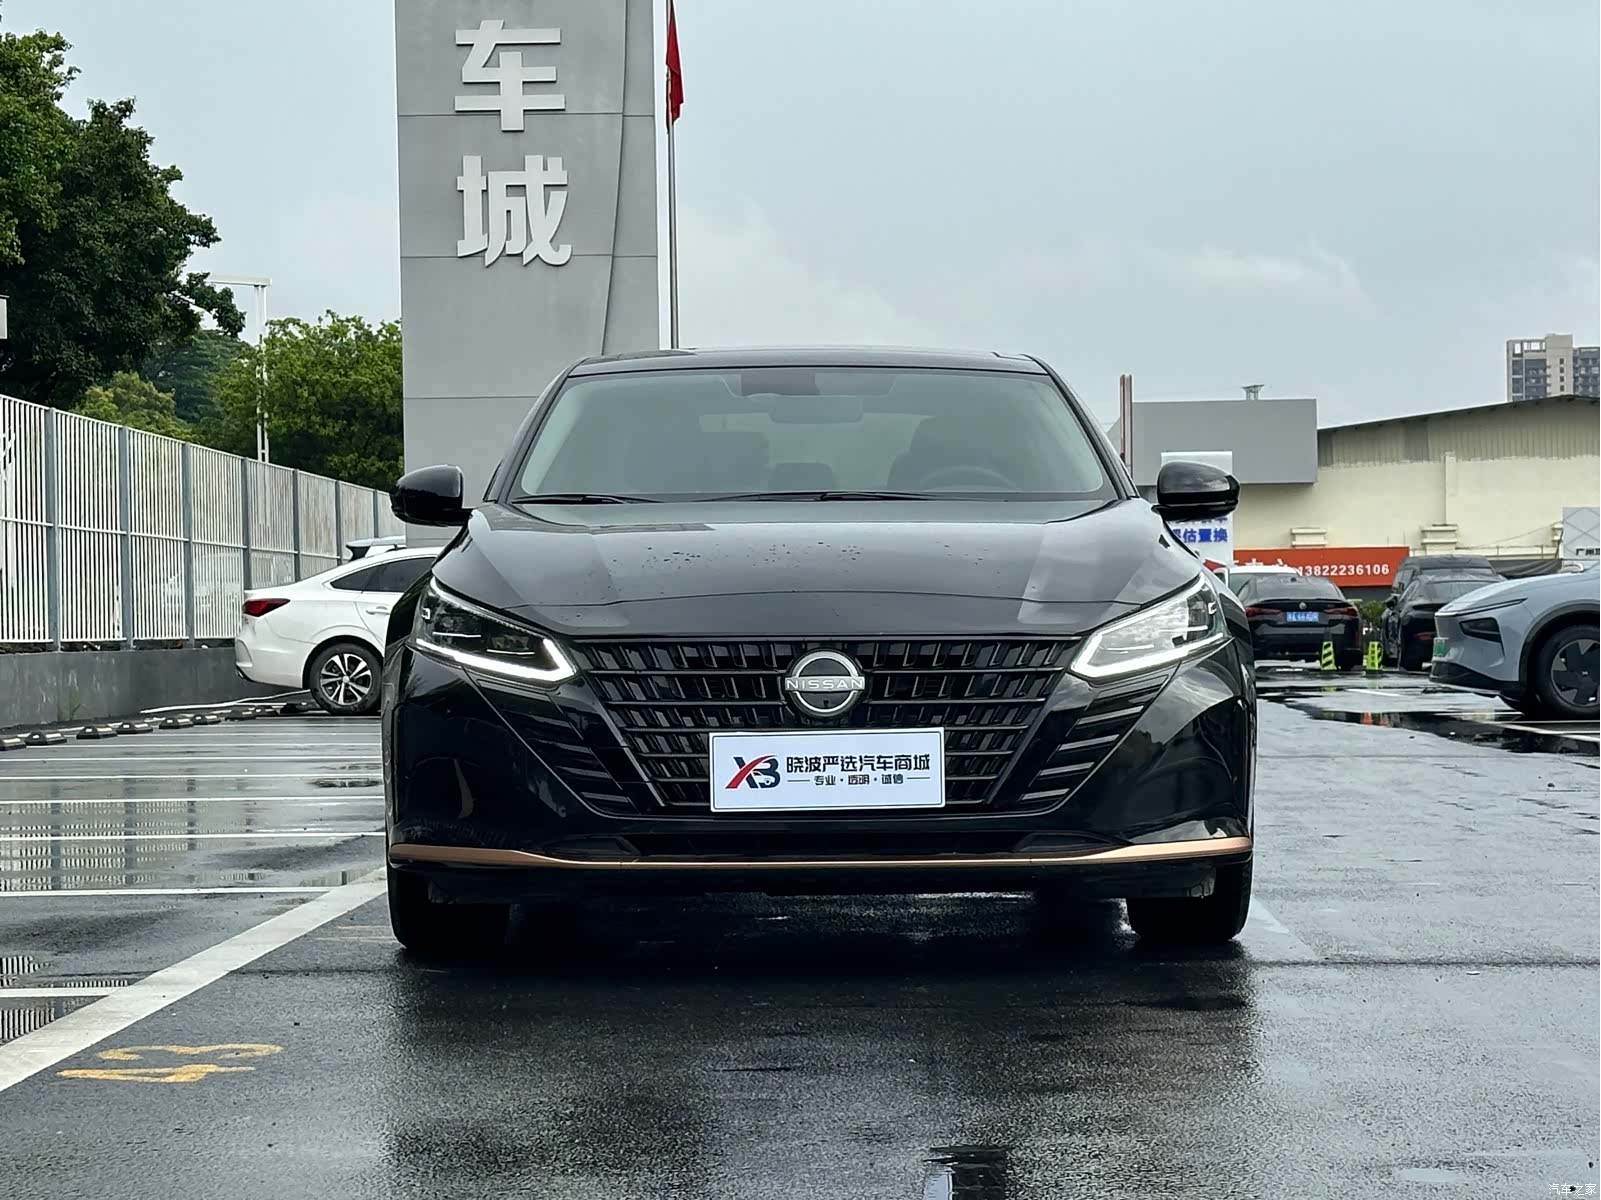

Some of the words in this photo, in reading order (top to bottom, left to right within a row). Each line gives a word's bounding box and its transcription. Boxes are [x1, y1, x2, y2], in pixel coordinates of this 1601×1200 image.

[454, 19, 572, 268] 车城
[786, 679, 863, 689] NISSAN
[786, 754, 930, 773] 晓波严选汽车商城
